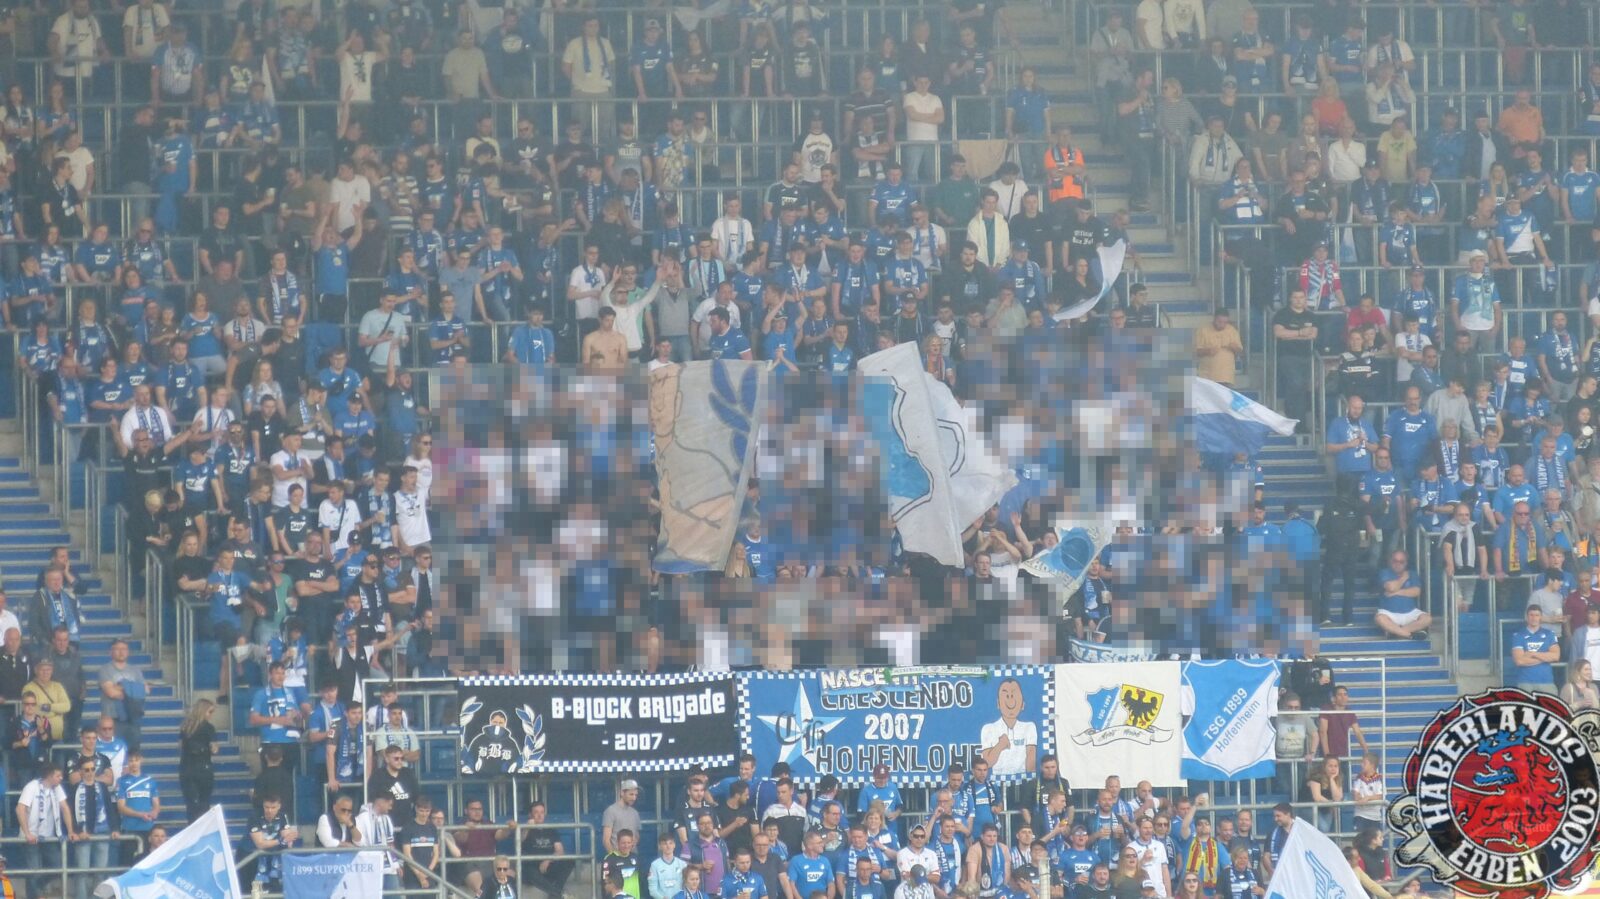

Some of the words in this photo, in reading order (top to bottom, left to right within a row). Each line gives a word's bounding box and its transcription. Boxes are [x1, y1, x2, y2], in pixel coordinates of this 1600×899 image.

[865, 713, 925, 740] 2007
[1203, 716, 1225, 741] TSG
[1223, 687, 1248, 716] 1899
[1216, 699, 1260, 753] Hoffenheim
[614, 733, 663, 750] 2007
[292, 865, 312, 875] 1899
[313, 863, 374, 875] SUPPORTER
